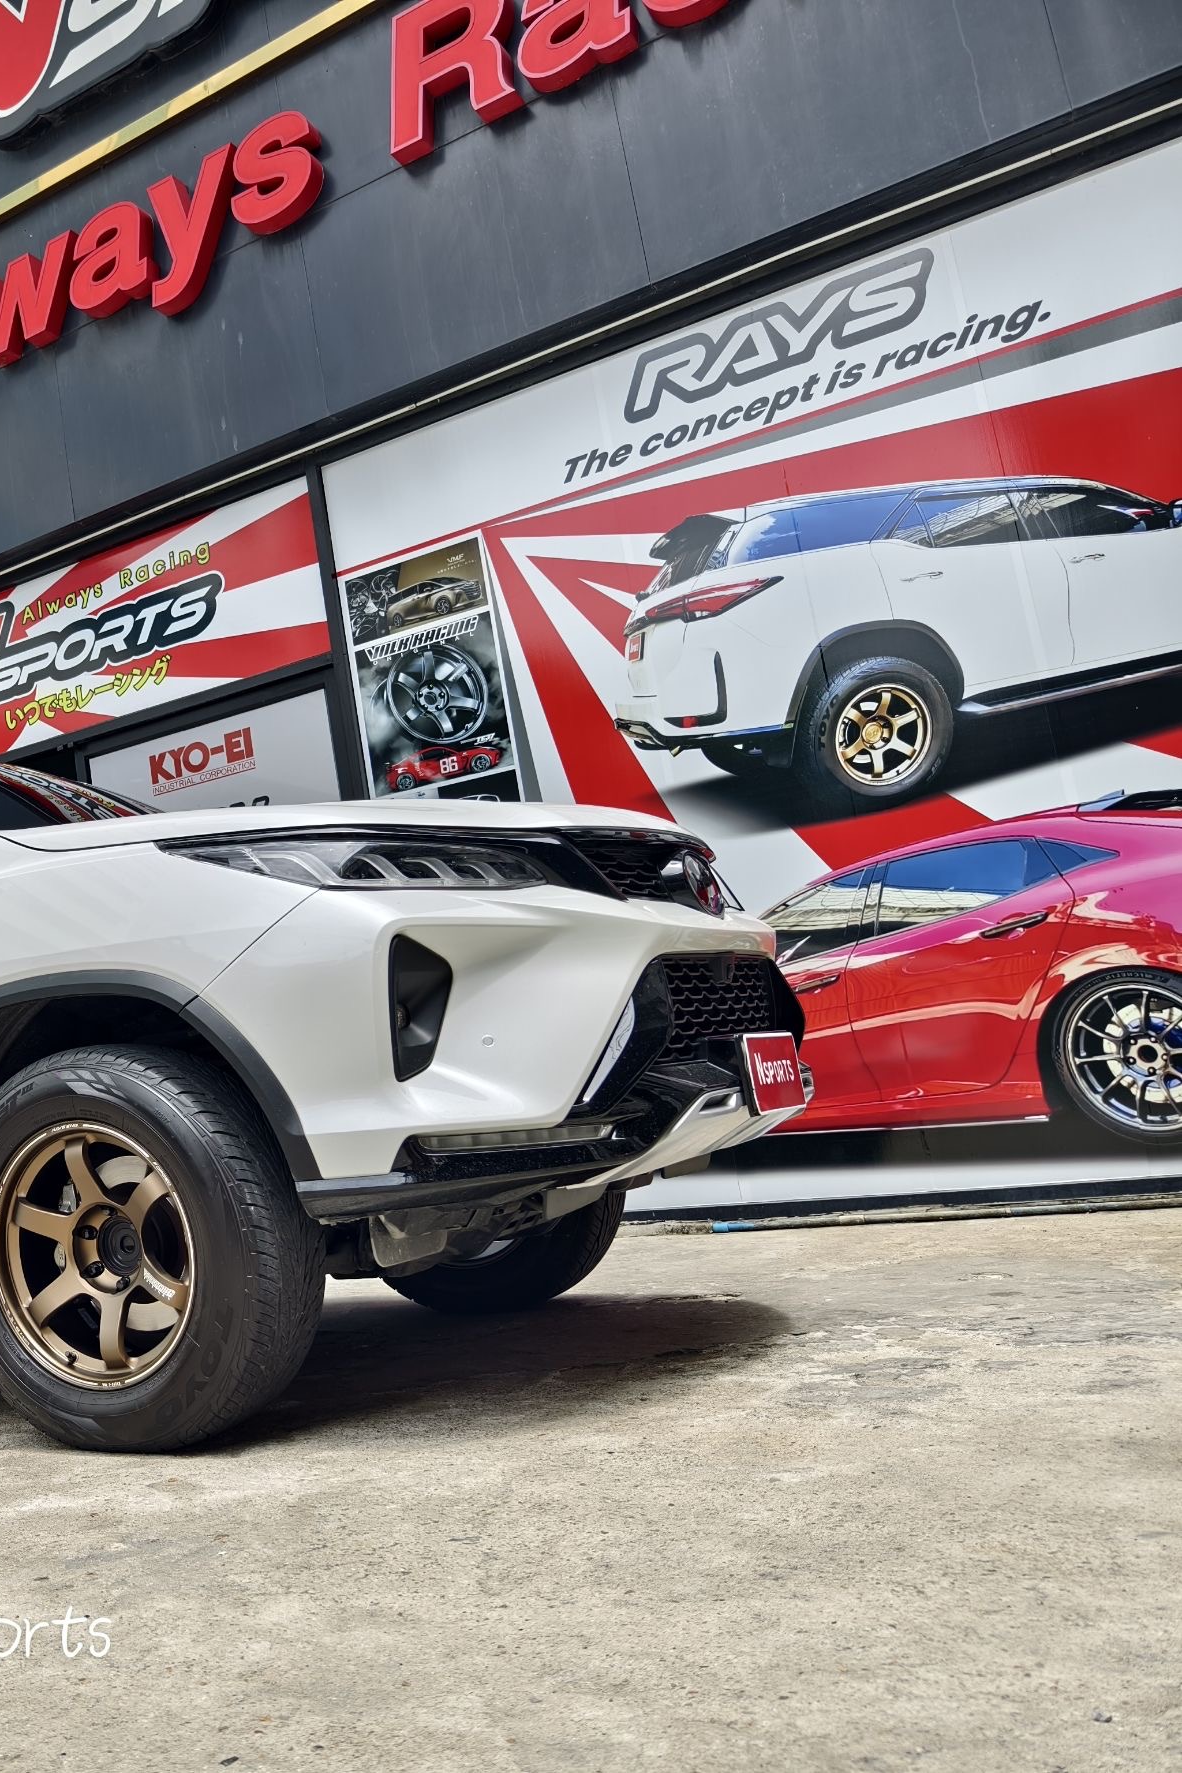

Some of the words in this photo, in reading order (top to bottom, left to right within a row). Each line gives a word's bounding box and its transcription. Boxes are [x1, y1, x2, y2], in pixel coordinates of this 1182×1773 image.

[389, 0, 730, 168] Ra
[625, 249, 933, 423] RAYS
[562, 448, 633, 485] The
[639, 373, 821, 457] concept
[823, 360, 868, 396] is
[872, 300, 1052, 379] racing.
[21, 582, 103, 626] Always
[118, 542, 211, 590] Racing
[4, 654, 172, 731] いつでもレーシング
[148, 726, 255, 785] KYO-EI
[152, 776, 197, 795] INDUSTRIAL
[199, 759, 256, 782] CORPORATION
[439, 755, 459, 775] 86
